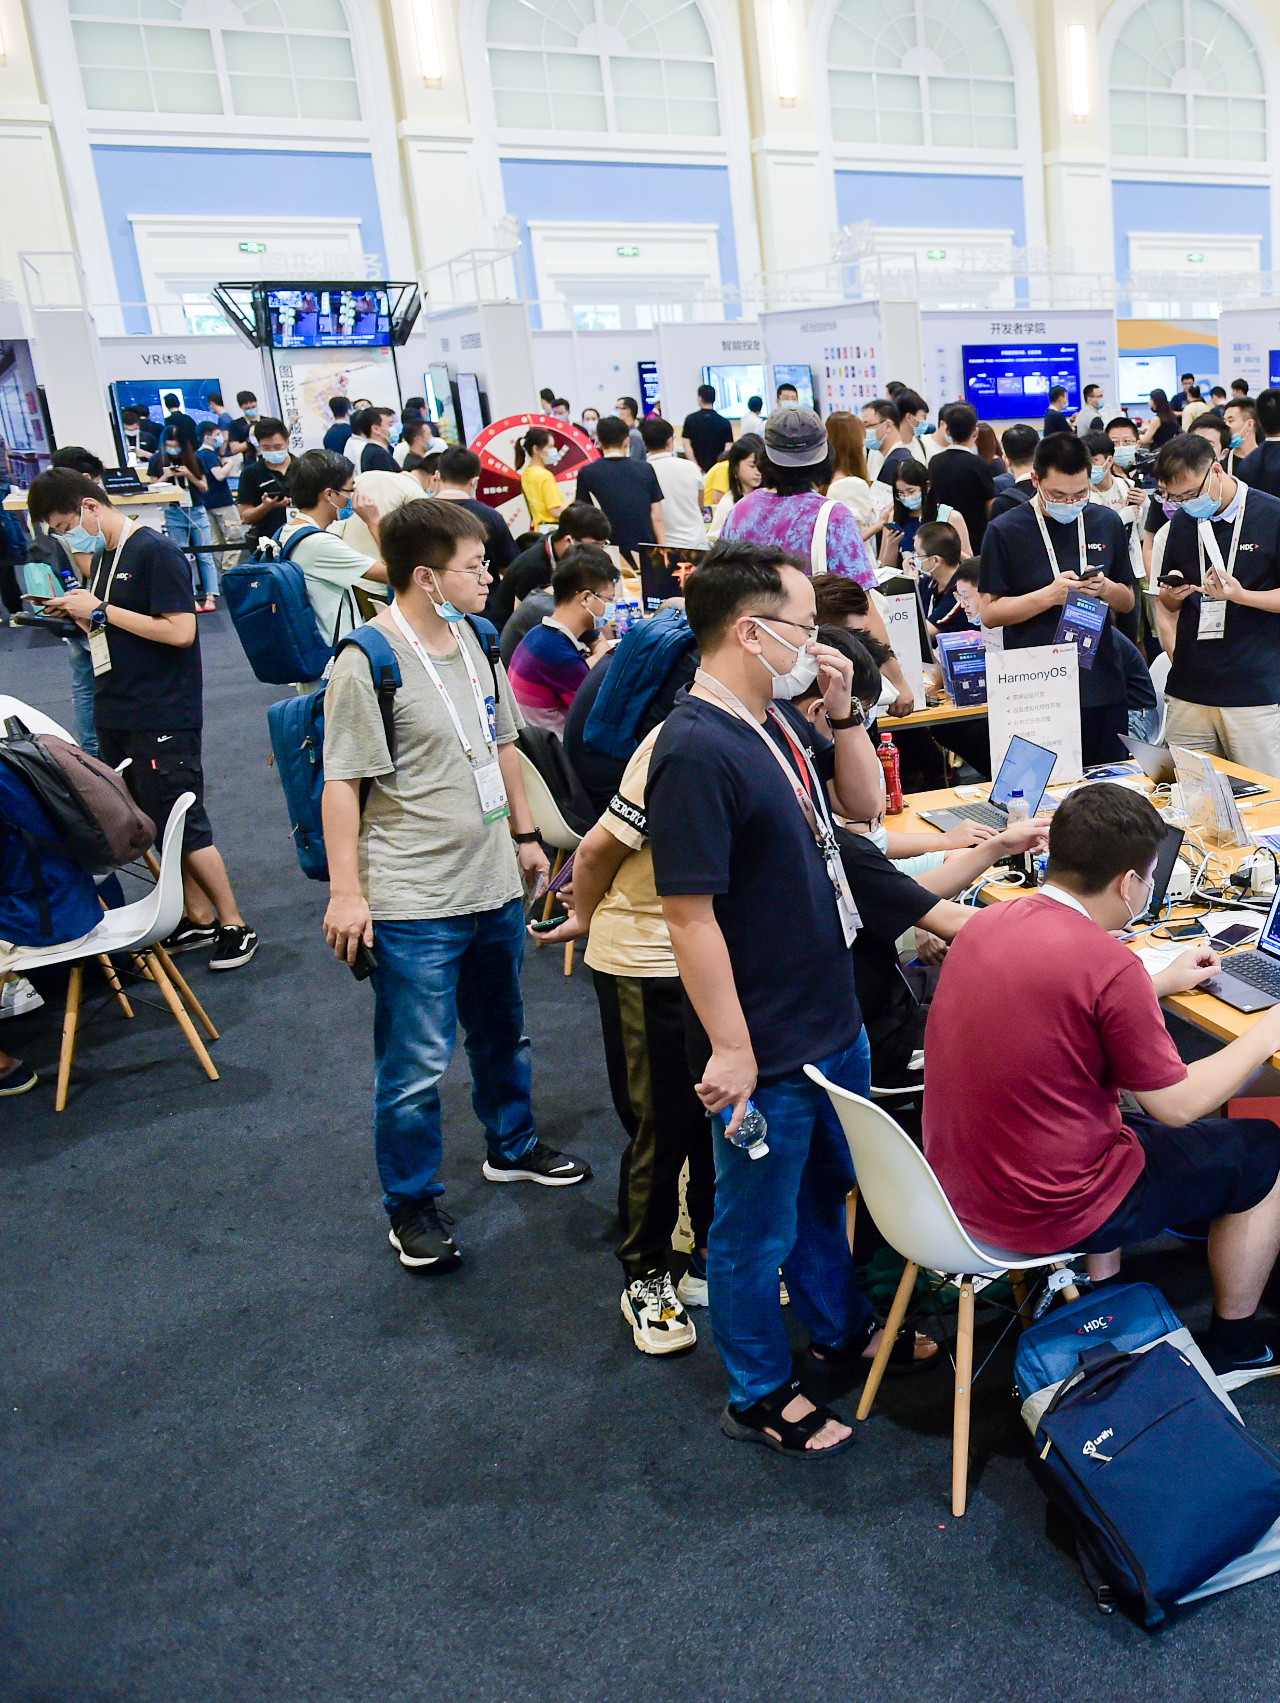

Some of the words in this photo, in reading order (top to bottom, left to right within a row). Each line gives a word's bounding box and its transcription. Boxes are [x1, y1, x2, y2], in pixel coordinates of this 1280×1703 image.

[990, 322, 1046, 336] 开发者学院
[141, 354, 188, 366] VR体验
[1240, 543, 1254, 551] HDC
[998, 667, 1068, 684] HarmonyOS
[1083, 1315, 1108, 1334] HDC
[1093, 1427, 1115, 1446] unity
